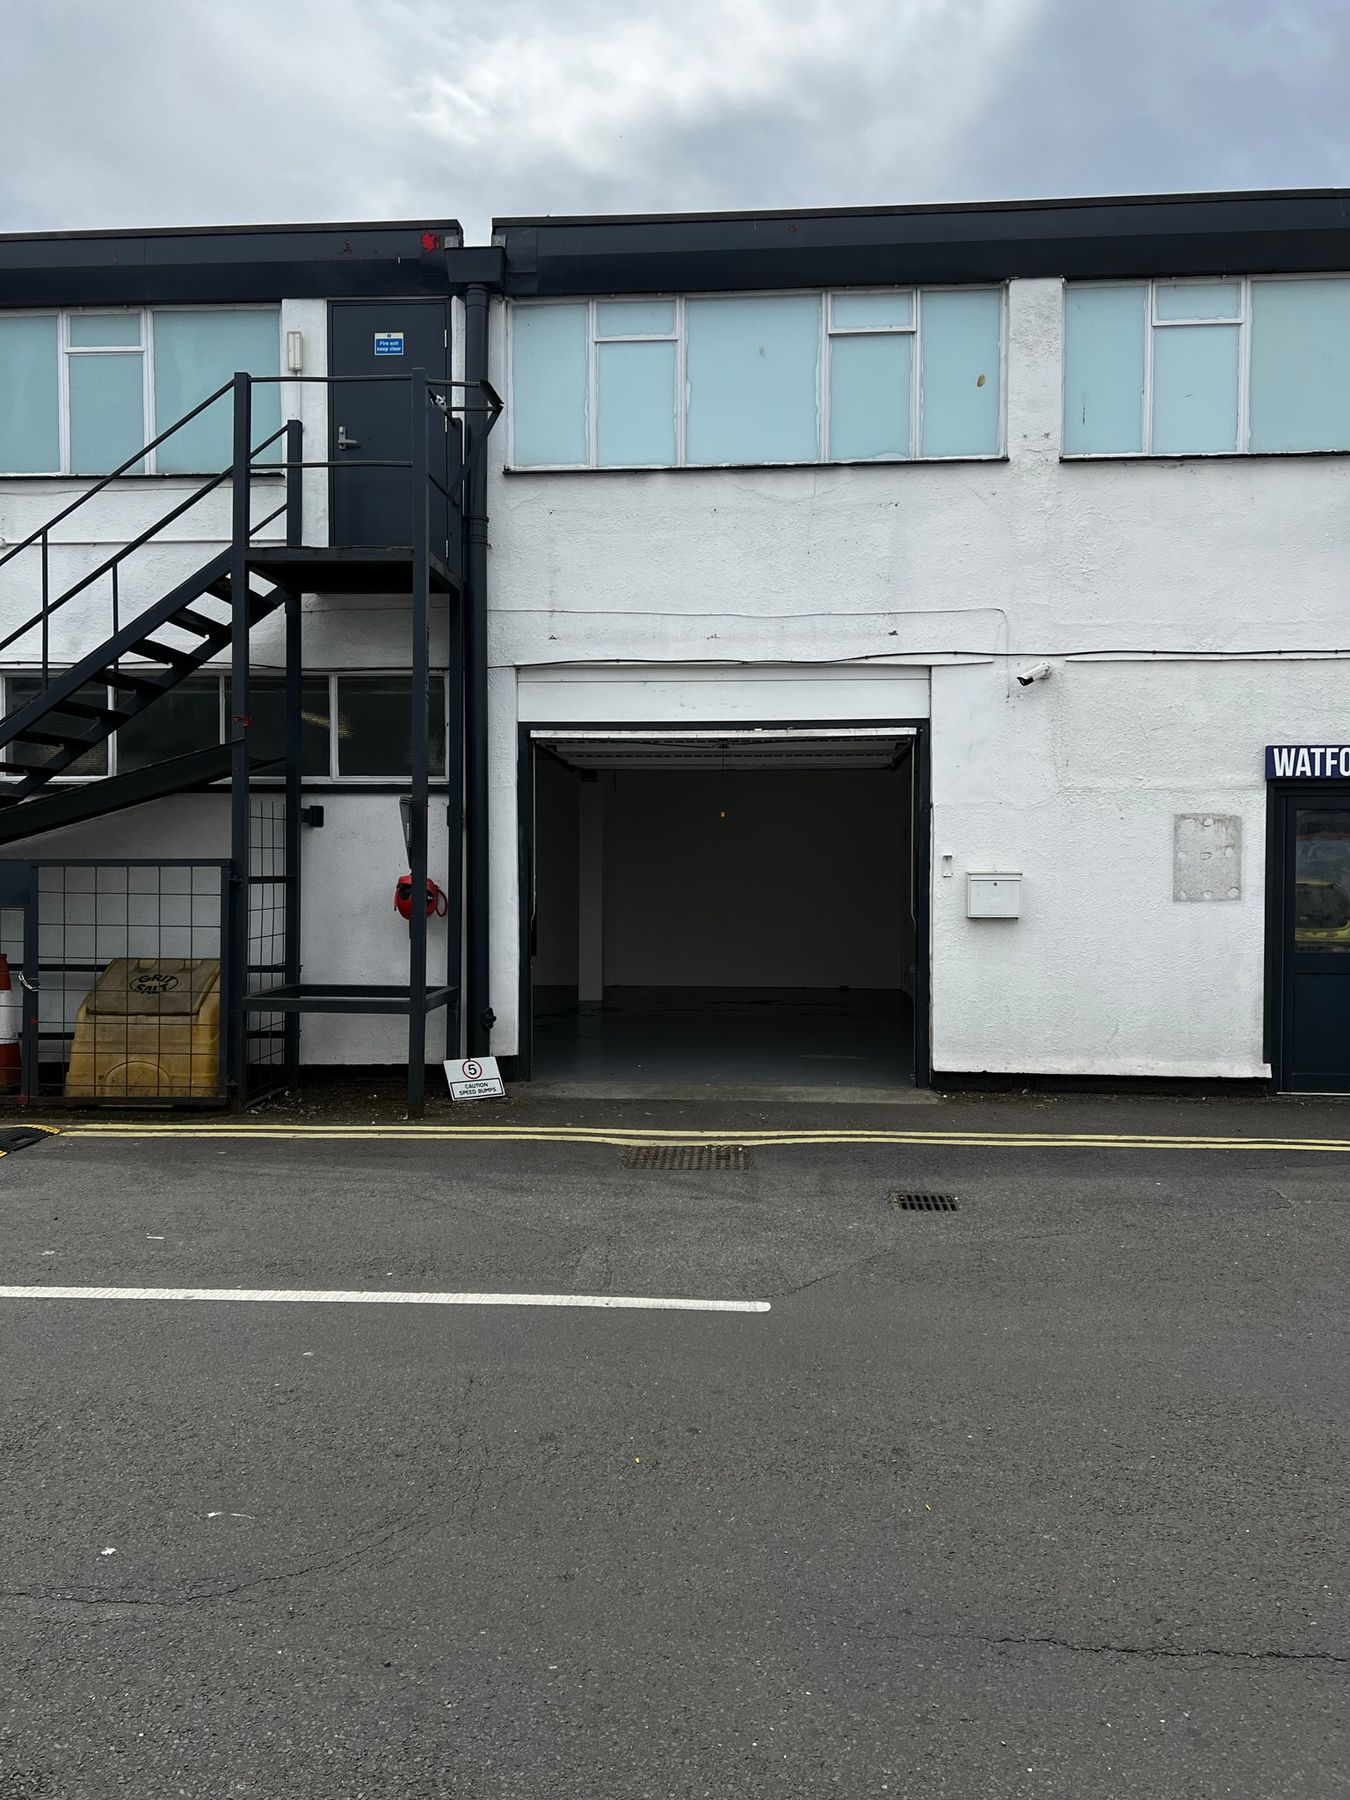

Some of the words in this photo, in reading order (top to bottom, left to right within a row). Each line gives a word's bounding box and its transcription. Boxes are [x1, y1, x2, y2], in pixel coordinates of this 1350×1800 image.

[1273, 747, 1350, 777] WATFO
[139, 974, 177, 983] GRIT
[136, 983, 168, 994] SALT
[468, 1063, 477, 1075] 5
